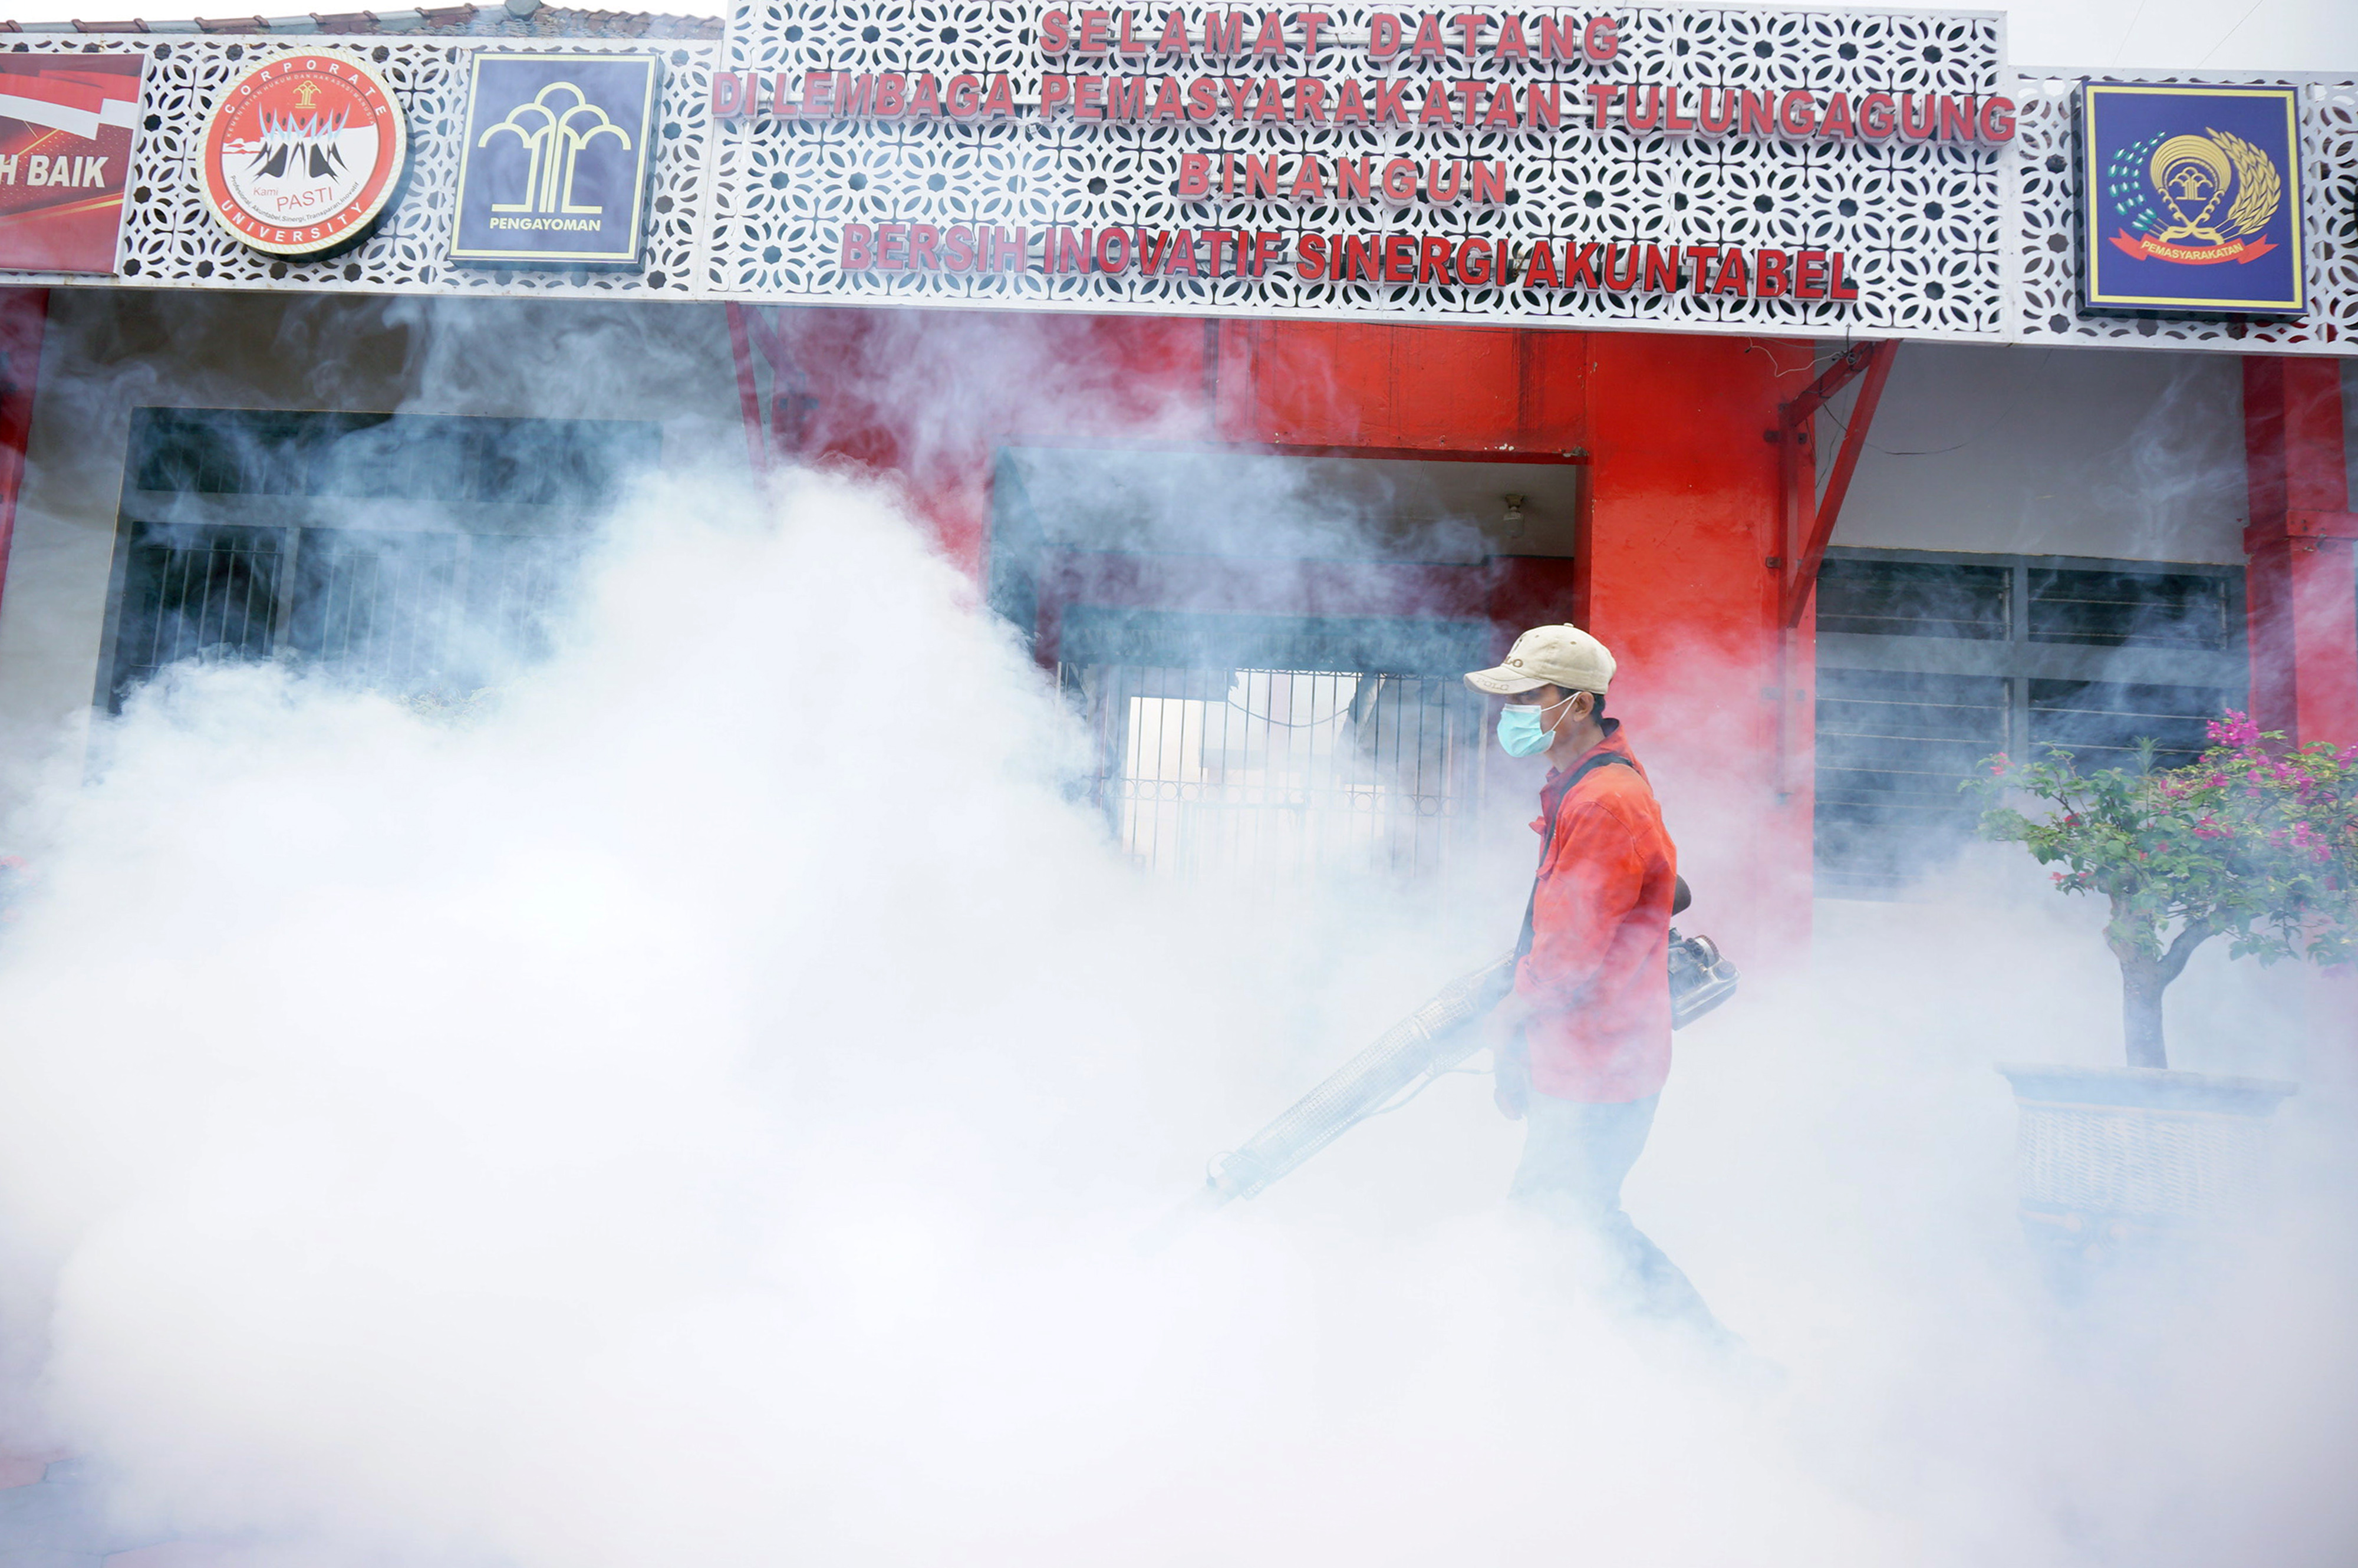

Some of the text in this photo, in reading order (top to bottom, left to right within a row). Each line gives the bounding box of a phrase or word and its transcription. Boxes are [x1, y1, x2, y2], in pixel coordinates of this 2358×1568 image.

[1039, 9, 1619, 65] SELAMAT DATANG
[224, 60, 387, 117] CORPORATE
[711, 71, 2016, 146] DI LEMBAGA PEMASYARAKATAN TULUNGAGUNG
[27, 155, 110, 187] BAIK
[253, 186, 278, 196] Kami
[1178, 153, 1507, 207] BINANGUN
[220, 199, 362, 242] UNIVERSITY
[276, 186, 333, 212] PASTI
[489, 216, 601, 232] PENGAYOMAN
[841, 223, 1859, 302] BERSIH INOVATIF SINERGI AKUNTABEL
[2141, 241, 2244, 259] PEMASYARAKATAN
